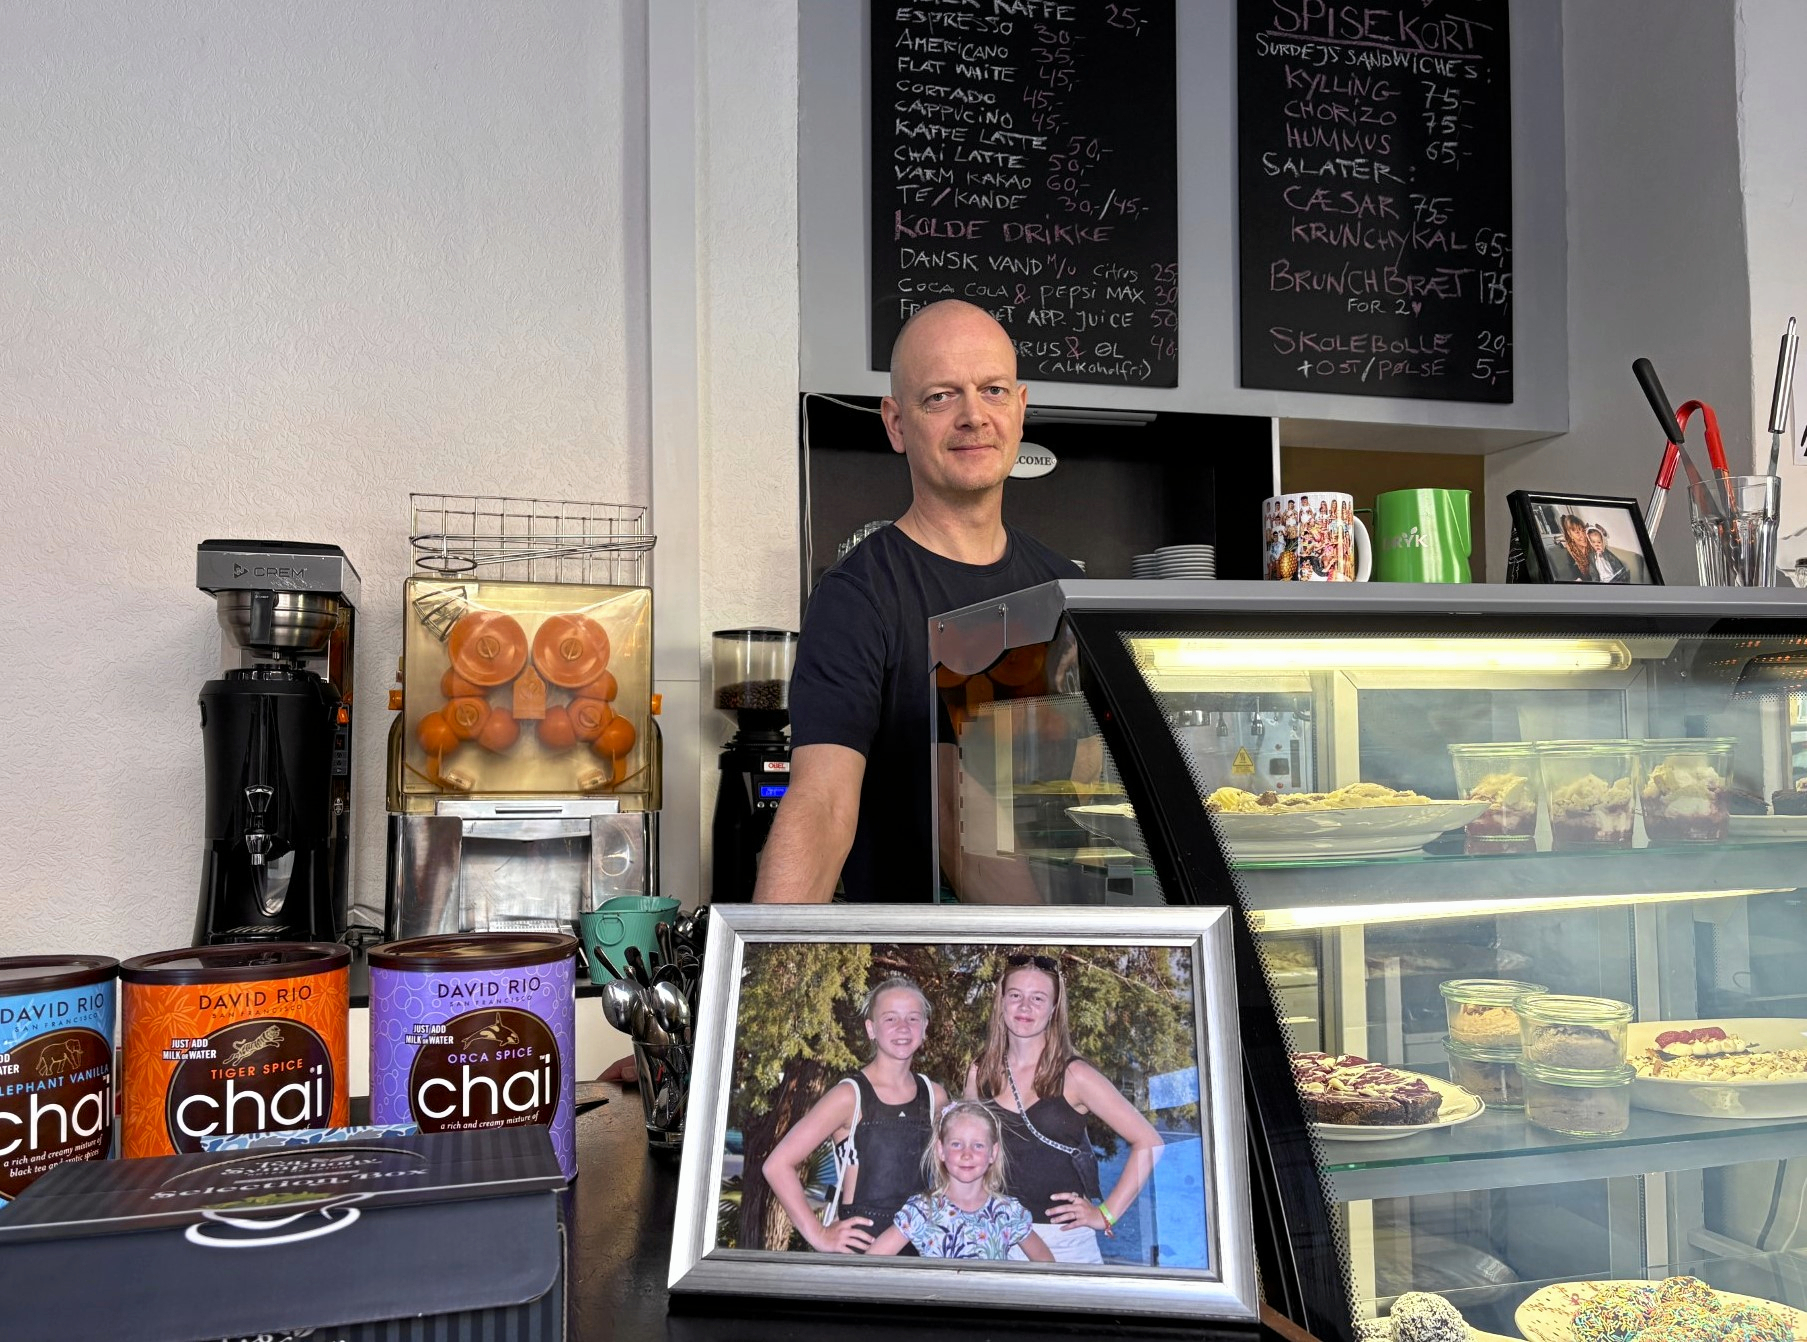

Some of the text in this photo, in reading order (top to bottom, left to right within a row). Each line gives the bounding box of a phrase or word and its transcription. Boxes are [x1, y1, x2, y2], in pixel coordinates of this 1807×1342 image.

[896, 8, 1013, 36] ESPRESSO
[898, 57, 947, 75] FLAT
[897, 80, 996, 104] CORTADO
[1285, 64, 1401, 101] KYLLING
[896, 119, 969, 142] KAFFE
[980, 131, 1048, 151] LATTE
[1286, 123, 1392, 155] HUMMUS
[955, 146, 1027, 169] LATTE
[894, 165, 954, 182] VARM
[967, 173, 1032, 189] KAKAO
[1284, 185, 1400, 219] CÆSAR
[895, 209, 990, 241] KOLDE
[901, 248, 979, 273] DANSK
[989, 256, 1043, 277] VAND
[1014, 283, 1031, 305] &
[1106, 286, 1147, 305] MAX
[1347, 298, 1411, 315] FOR 2
[1065, 337, 1088, 360] &
[1269, 327, 1455, 355] SKOLEBOLLE
[253, 566, 305, 579] CREM
[199, 985, 312, 1011] DAVID RIO
[438, 977, 541, 999] DAVID RIO
[0, 993, 105, 1025] DAVID RIO
[475, 995, 533, 1006] FRANCISCO
[14, 1012, 98, 1033] SAN FRANCISCO
[212, 1011, 235, 1019] SAN
[405, 1034, 422, 1045] MILK
[429, 1035, 454, 1045] WATER
[413, 1024, 447, 1034] JUST ADD
[162, 1050, 181, 1060] MILK
[189, 1049, 217, 1060] WATER
[171, 1038, 209, 1049] JUST ADD
[447, 1046, 533, 1064] ORCA SPICE
[0, 1064, 110, 1097] LEPHANT VANILLA
[211, 1058, 304, 1080] TIGER SPICE
[418, 1053, 552, 1120] chai
[176, 1064, 323, 1138] chai
[447, 1121, 461, 1130] rich
[463, 1120, 478, 1129] and
[479, 1119, 505, 1129] creamy
[506, 1114, 531, 1125] mixture
[531, 1110, 540, 1122] of
[3, 1133, 104, 1168] a rich and creamy mixture of
[10, 1165, 33, 1178] black
[35, 1163, 47, 1173] tea
[150, 1168, 429, 1200] Selection Box
